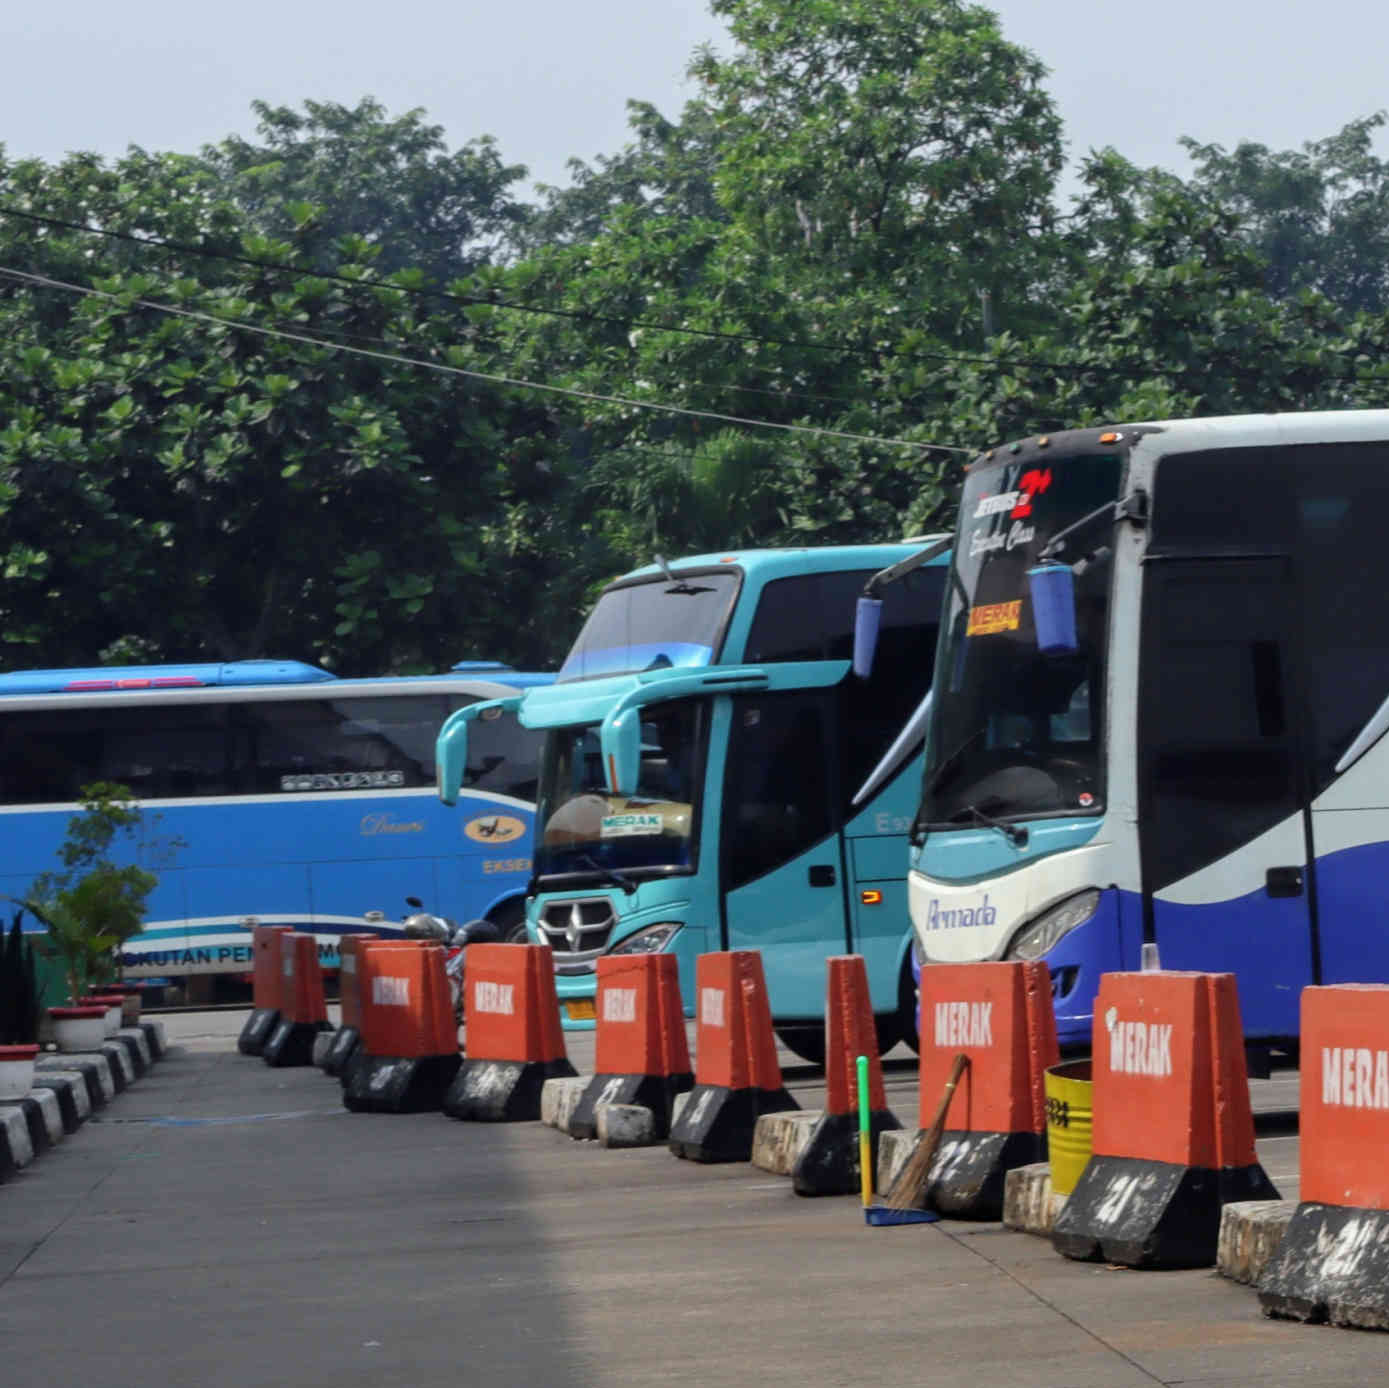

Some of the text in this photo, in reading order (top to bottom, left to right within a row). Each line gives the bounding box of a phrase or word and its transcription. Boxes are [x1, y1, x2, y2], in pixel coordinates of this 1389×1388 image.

[926, 896, 997, 931] Armada
[934, 1001, 993, 1047] MERAK
[1109, 1020, 1172, 1076] MERAK
